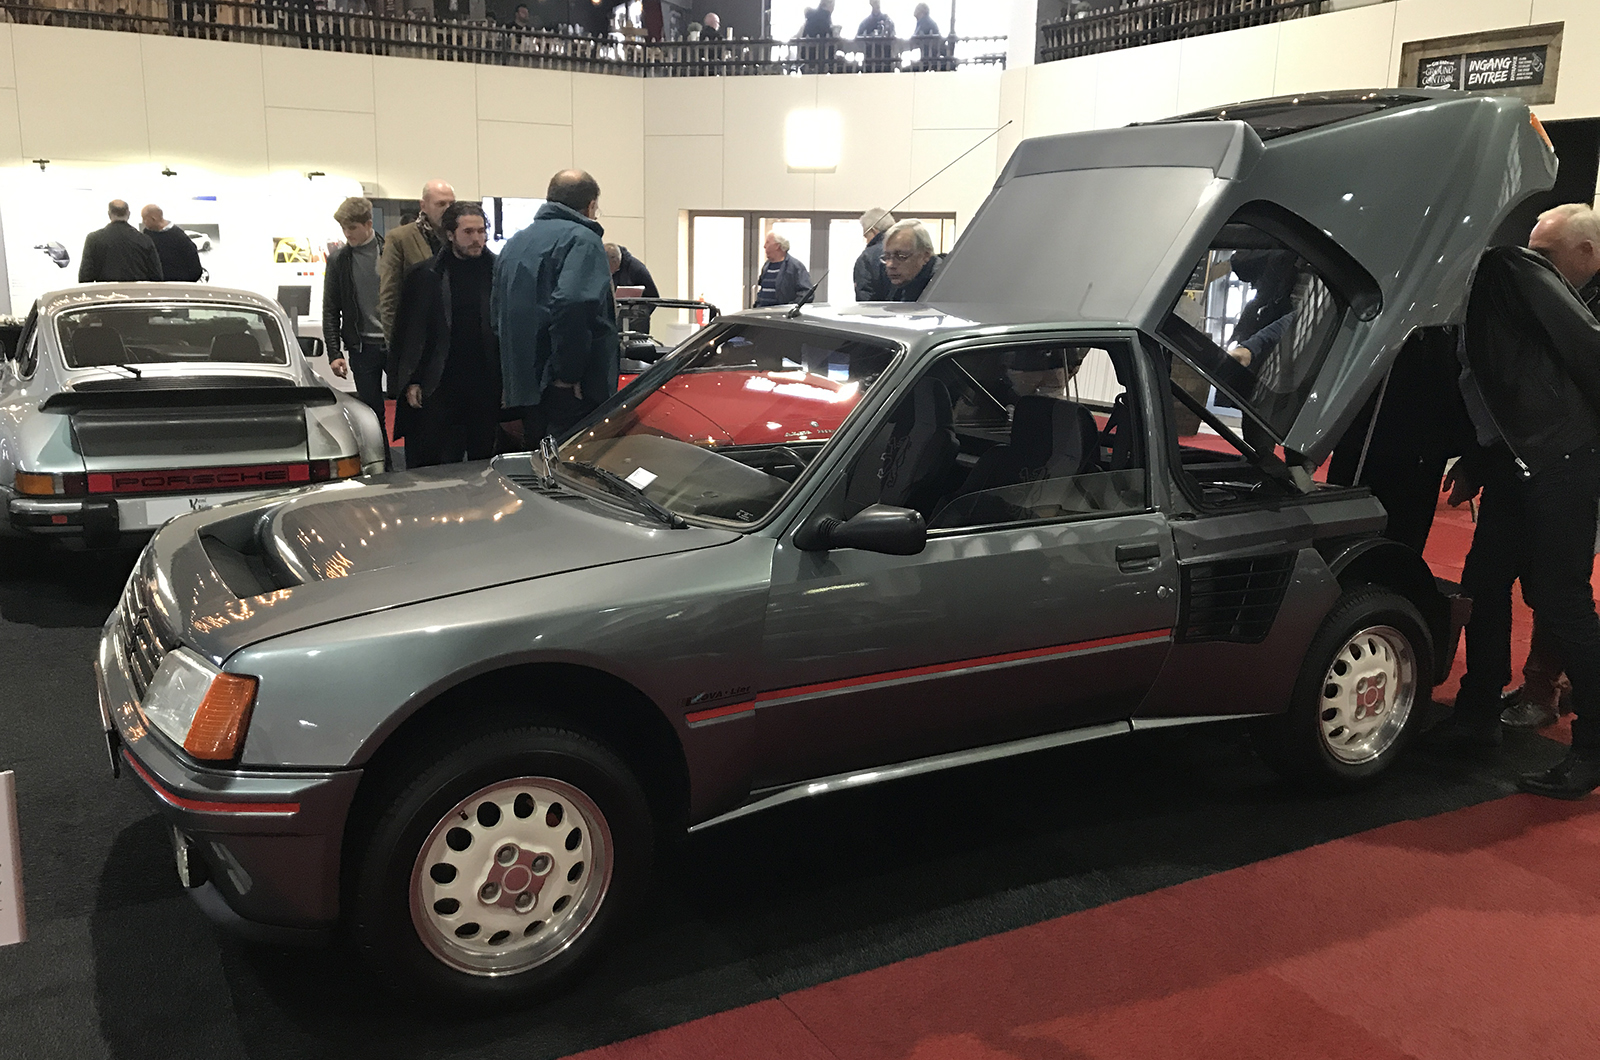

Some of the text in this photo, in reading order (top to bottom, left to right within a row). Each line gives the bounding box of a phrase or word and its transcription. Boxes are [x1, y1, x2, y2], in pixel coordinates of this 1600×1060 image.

[1469, 57, 1512, 72] INGANG
[1468, 70, 1509, 85] ENTREE
[115, 470, 287, 488] PORSCHE
